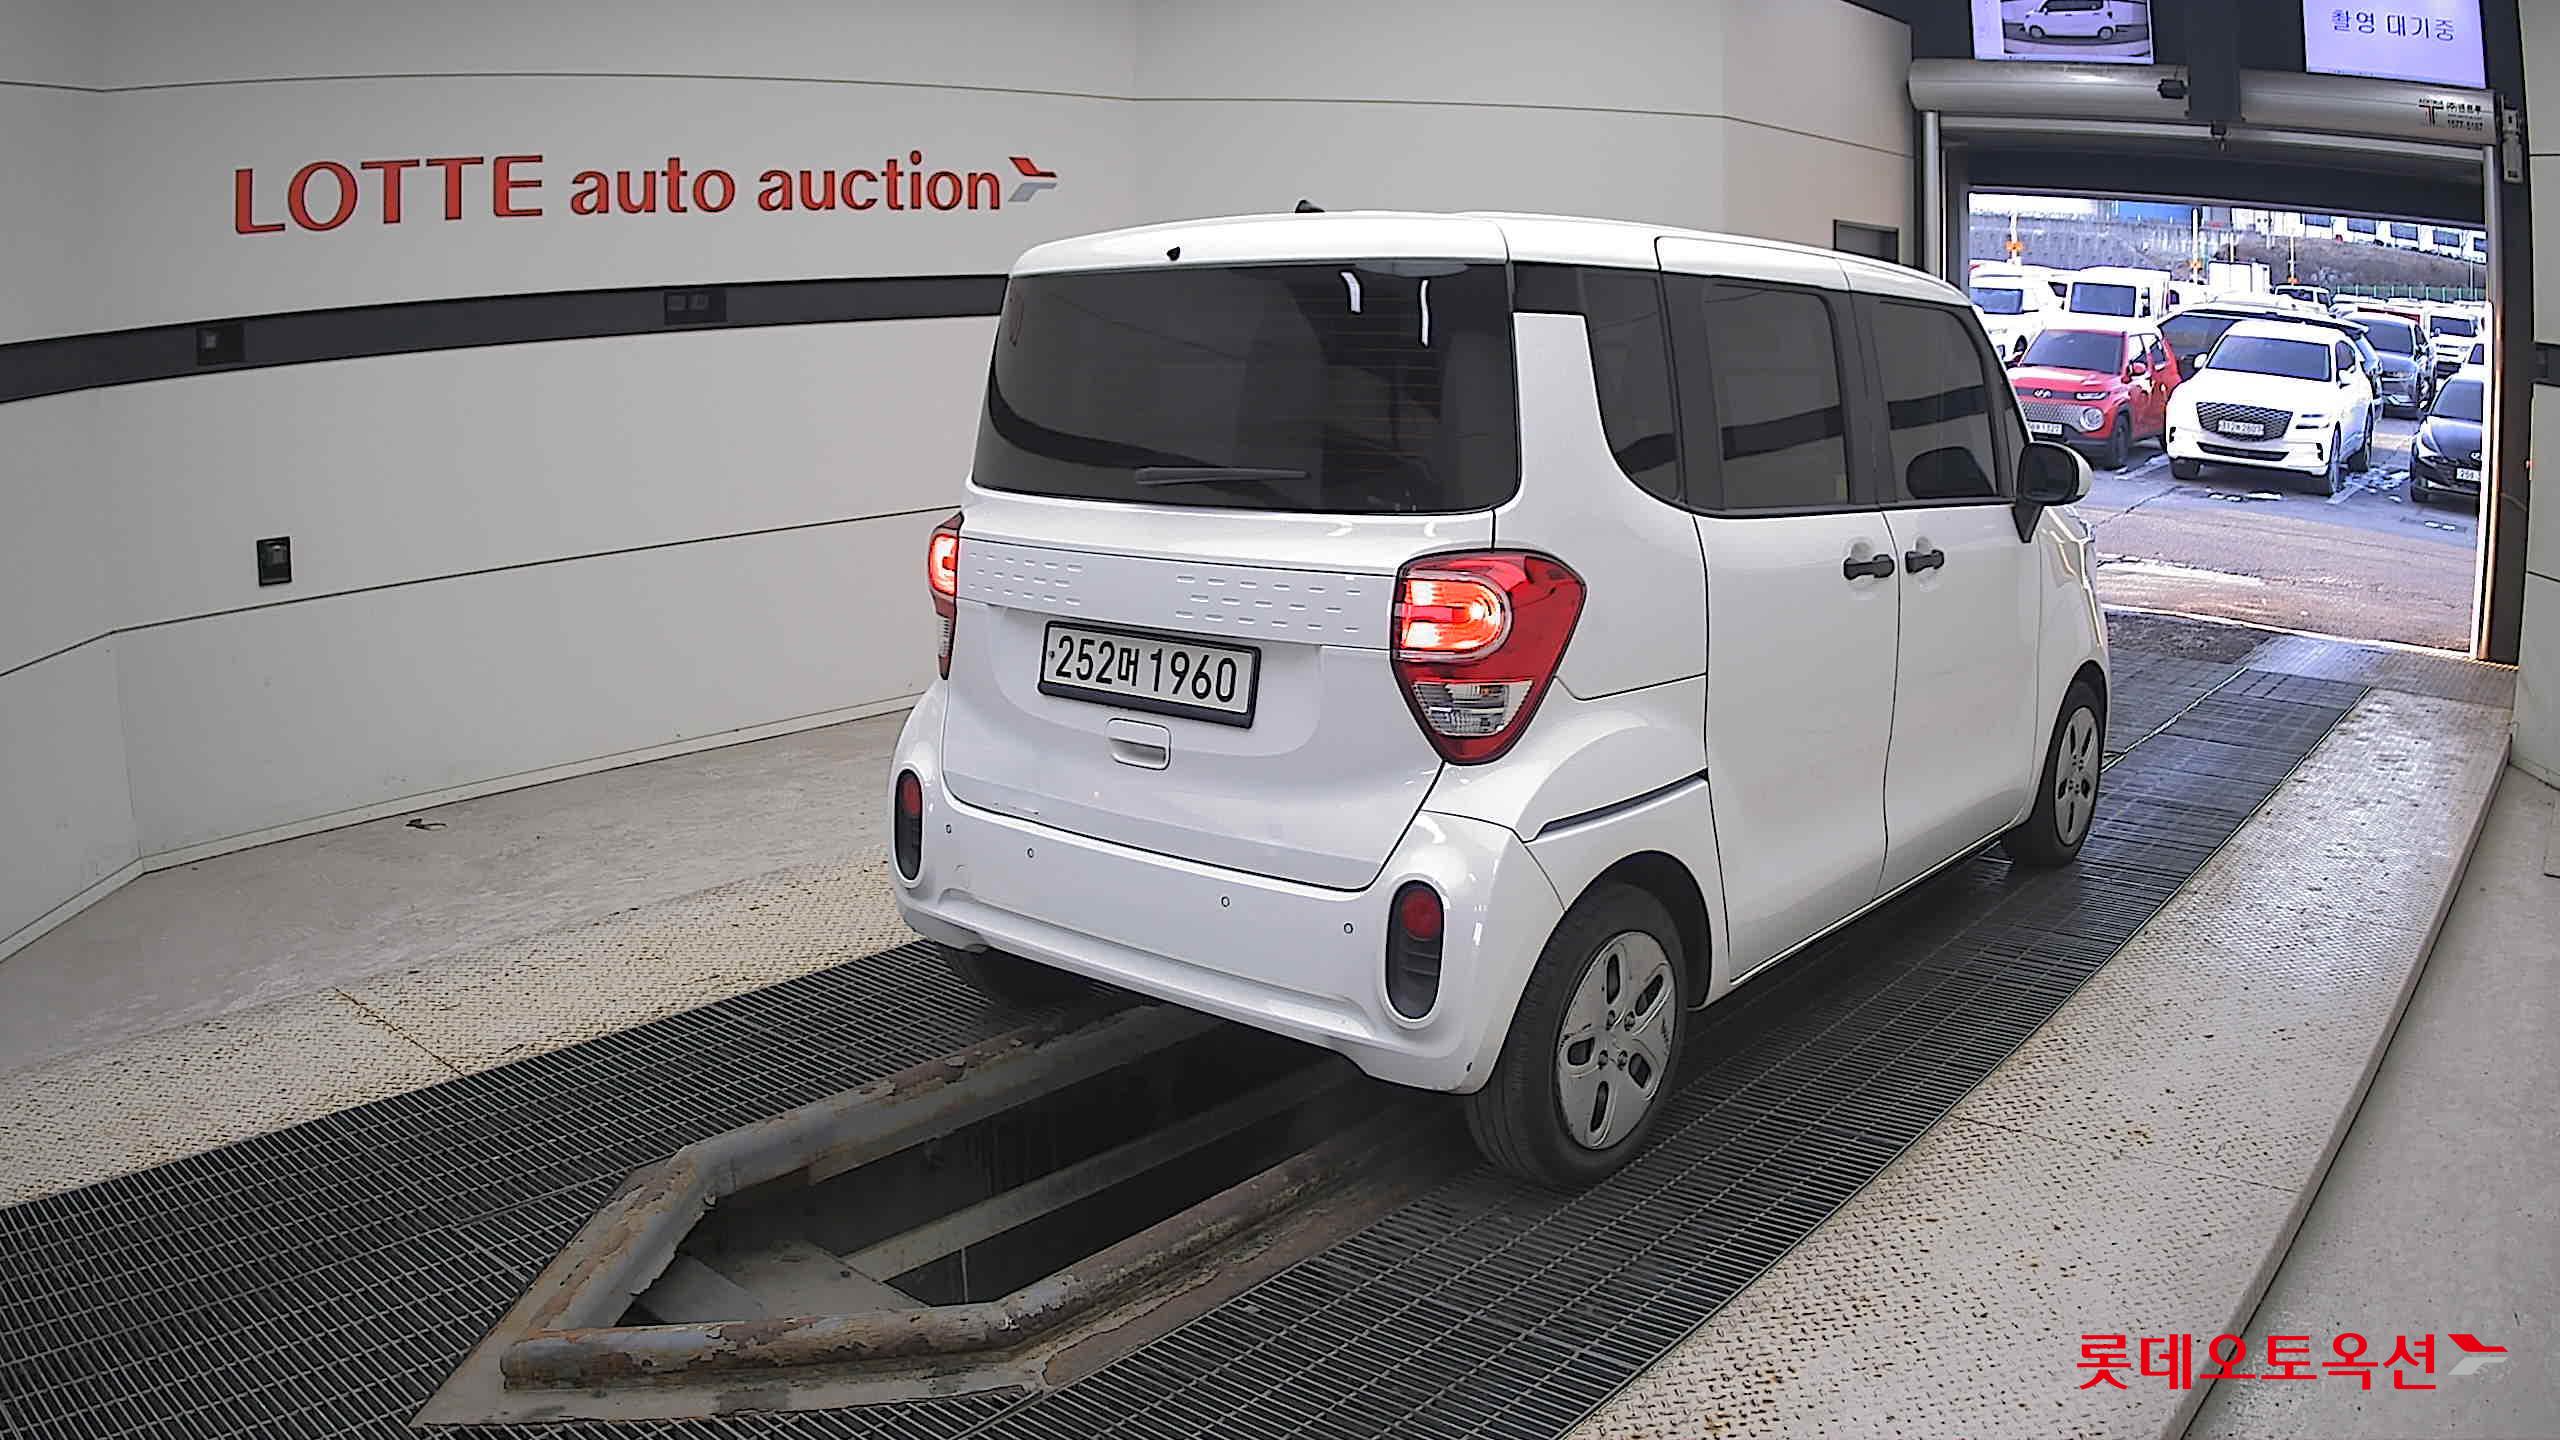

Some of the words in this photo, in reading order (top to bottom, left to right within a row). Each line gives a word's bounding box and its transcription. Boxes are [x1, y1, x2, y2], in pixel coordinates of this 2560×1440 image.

[2331, 9, 2376, 34] 촬영
[2387, 14, 2455, 42] 대기중
[235, 155, 542, 233] LOTTE
[570, 158, 736, 214] auto
[758, 150, 1001, 211] auction
